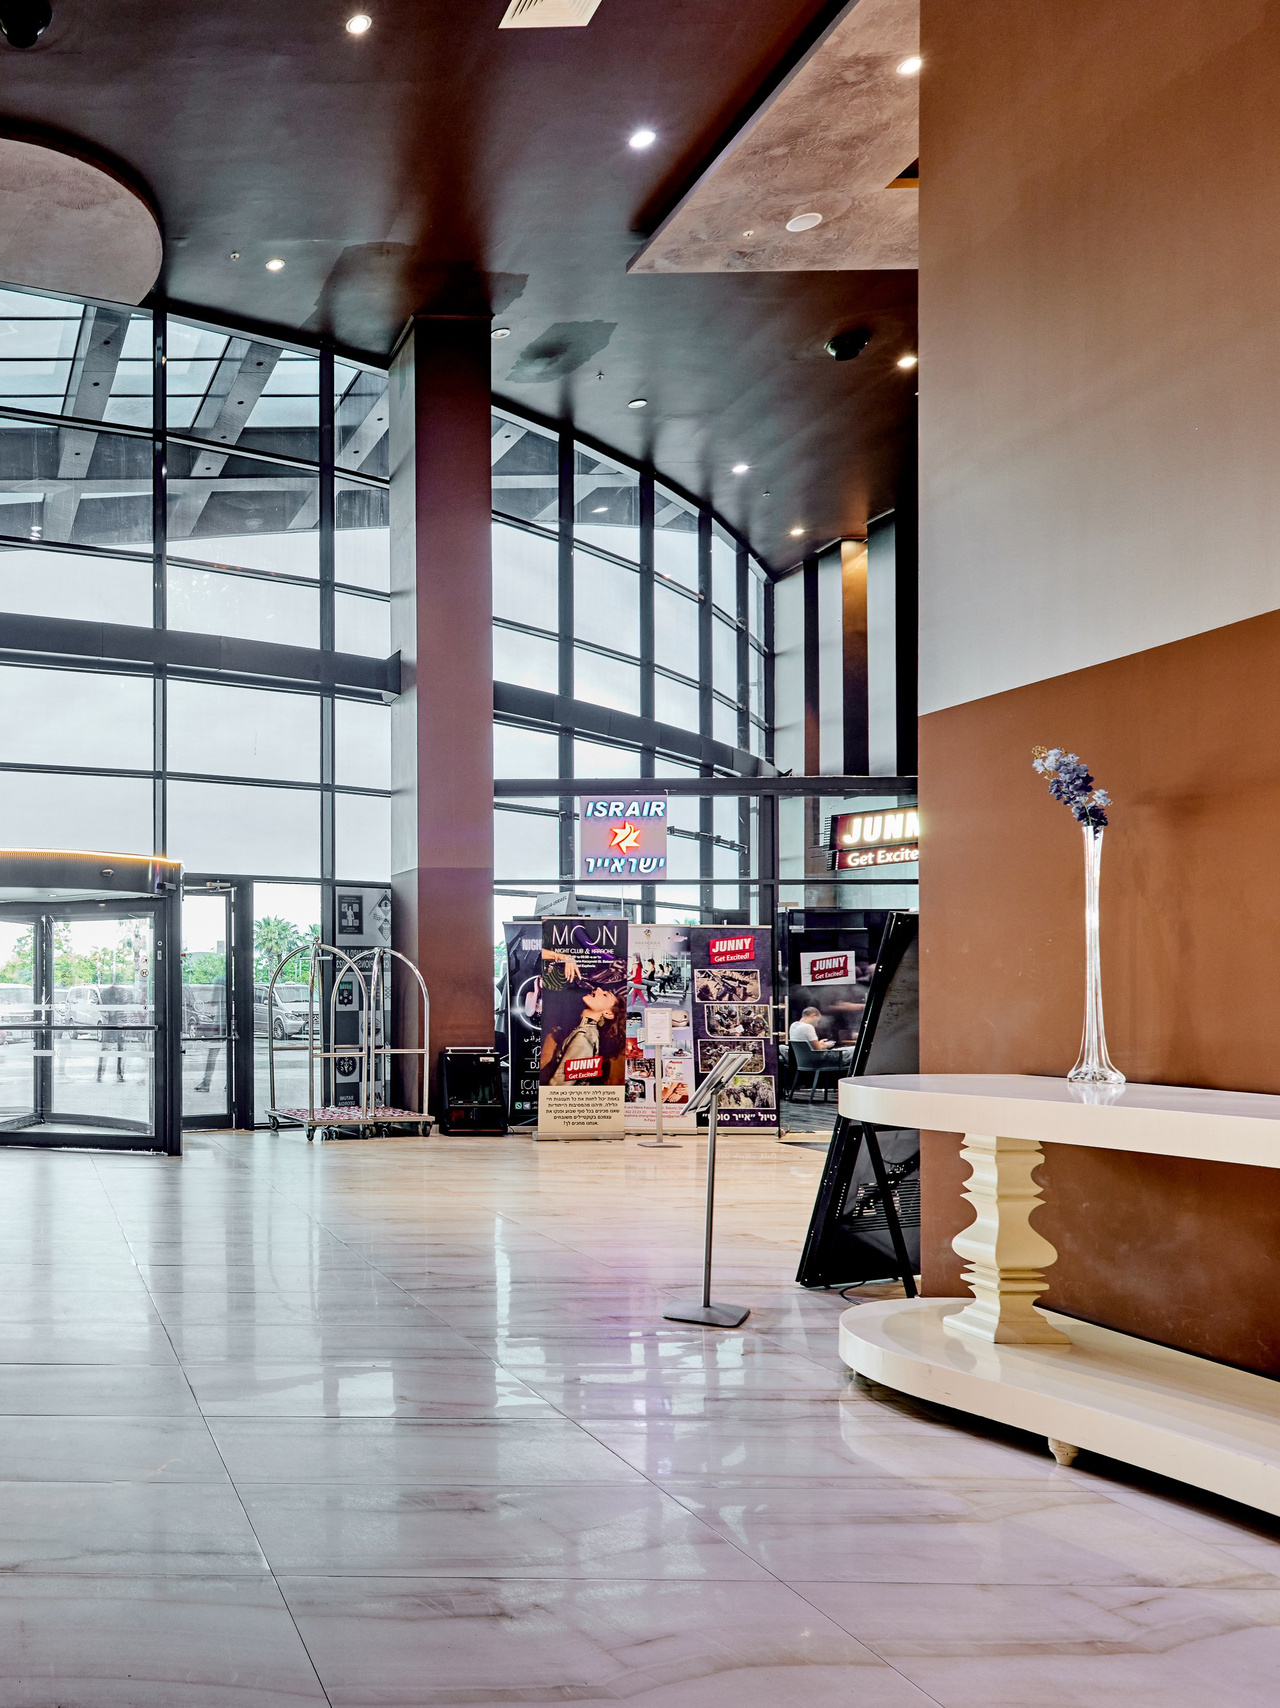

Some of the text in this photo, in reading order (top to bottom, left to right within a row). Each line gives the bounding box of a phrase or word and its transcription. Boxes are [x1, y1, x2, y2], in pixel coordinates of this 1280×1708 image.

[585, 800, 666, 818] ISRAIR
[843, 812, 919, 844] JUNN
[585, 856, 666, 875] ישראייר
[848, 848, 919, 867] Get Excite
[552, 924, 618, 946] MOON
[522, 938, 542, 950] NIGH
[712, 938, 752, 954] JUNNY
[726, 952, 750, 962] Excited!
[813, 956, 846, 972] JUNNY
[825, 970, 844, 978] Excited!
[566, 1058, 601, 1071] JUNNY
[758, 1112, 777, 1121] טיול
